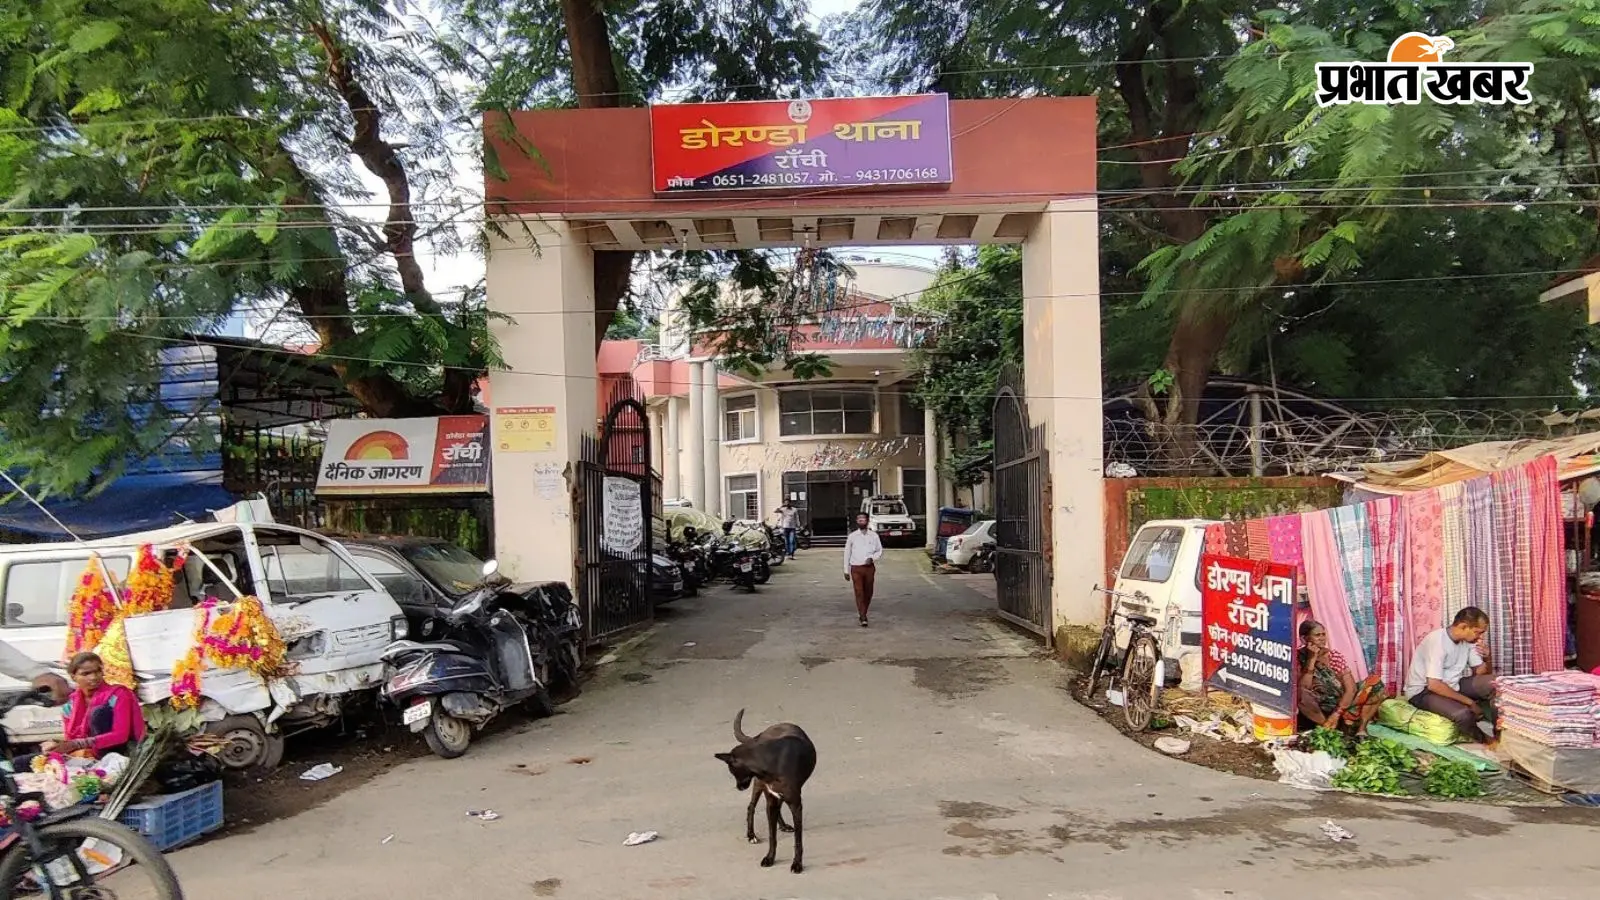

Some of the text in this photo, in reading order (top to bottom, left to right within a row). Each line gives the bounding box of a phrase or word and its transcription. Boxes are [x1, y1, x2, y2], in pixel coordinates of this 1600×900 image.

[679, 118, 922, 150] डोरण्डा थाना
[774, 148, 828, 169] राँची
[667, 175, 696, 188] फोन
[856, 167, 938, 181] 9431706168
[442, 442, 483, 461] राँची
[325, 462, 424, 480] दैनिक जागरण
[1227, 597, 1269, 631] राँची
